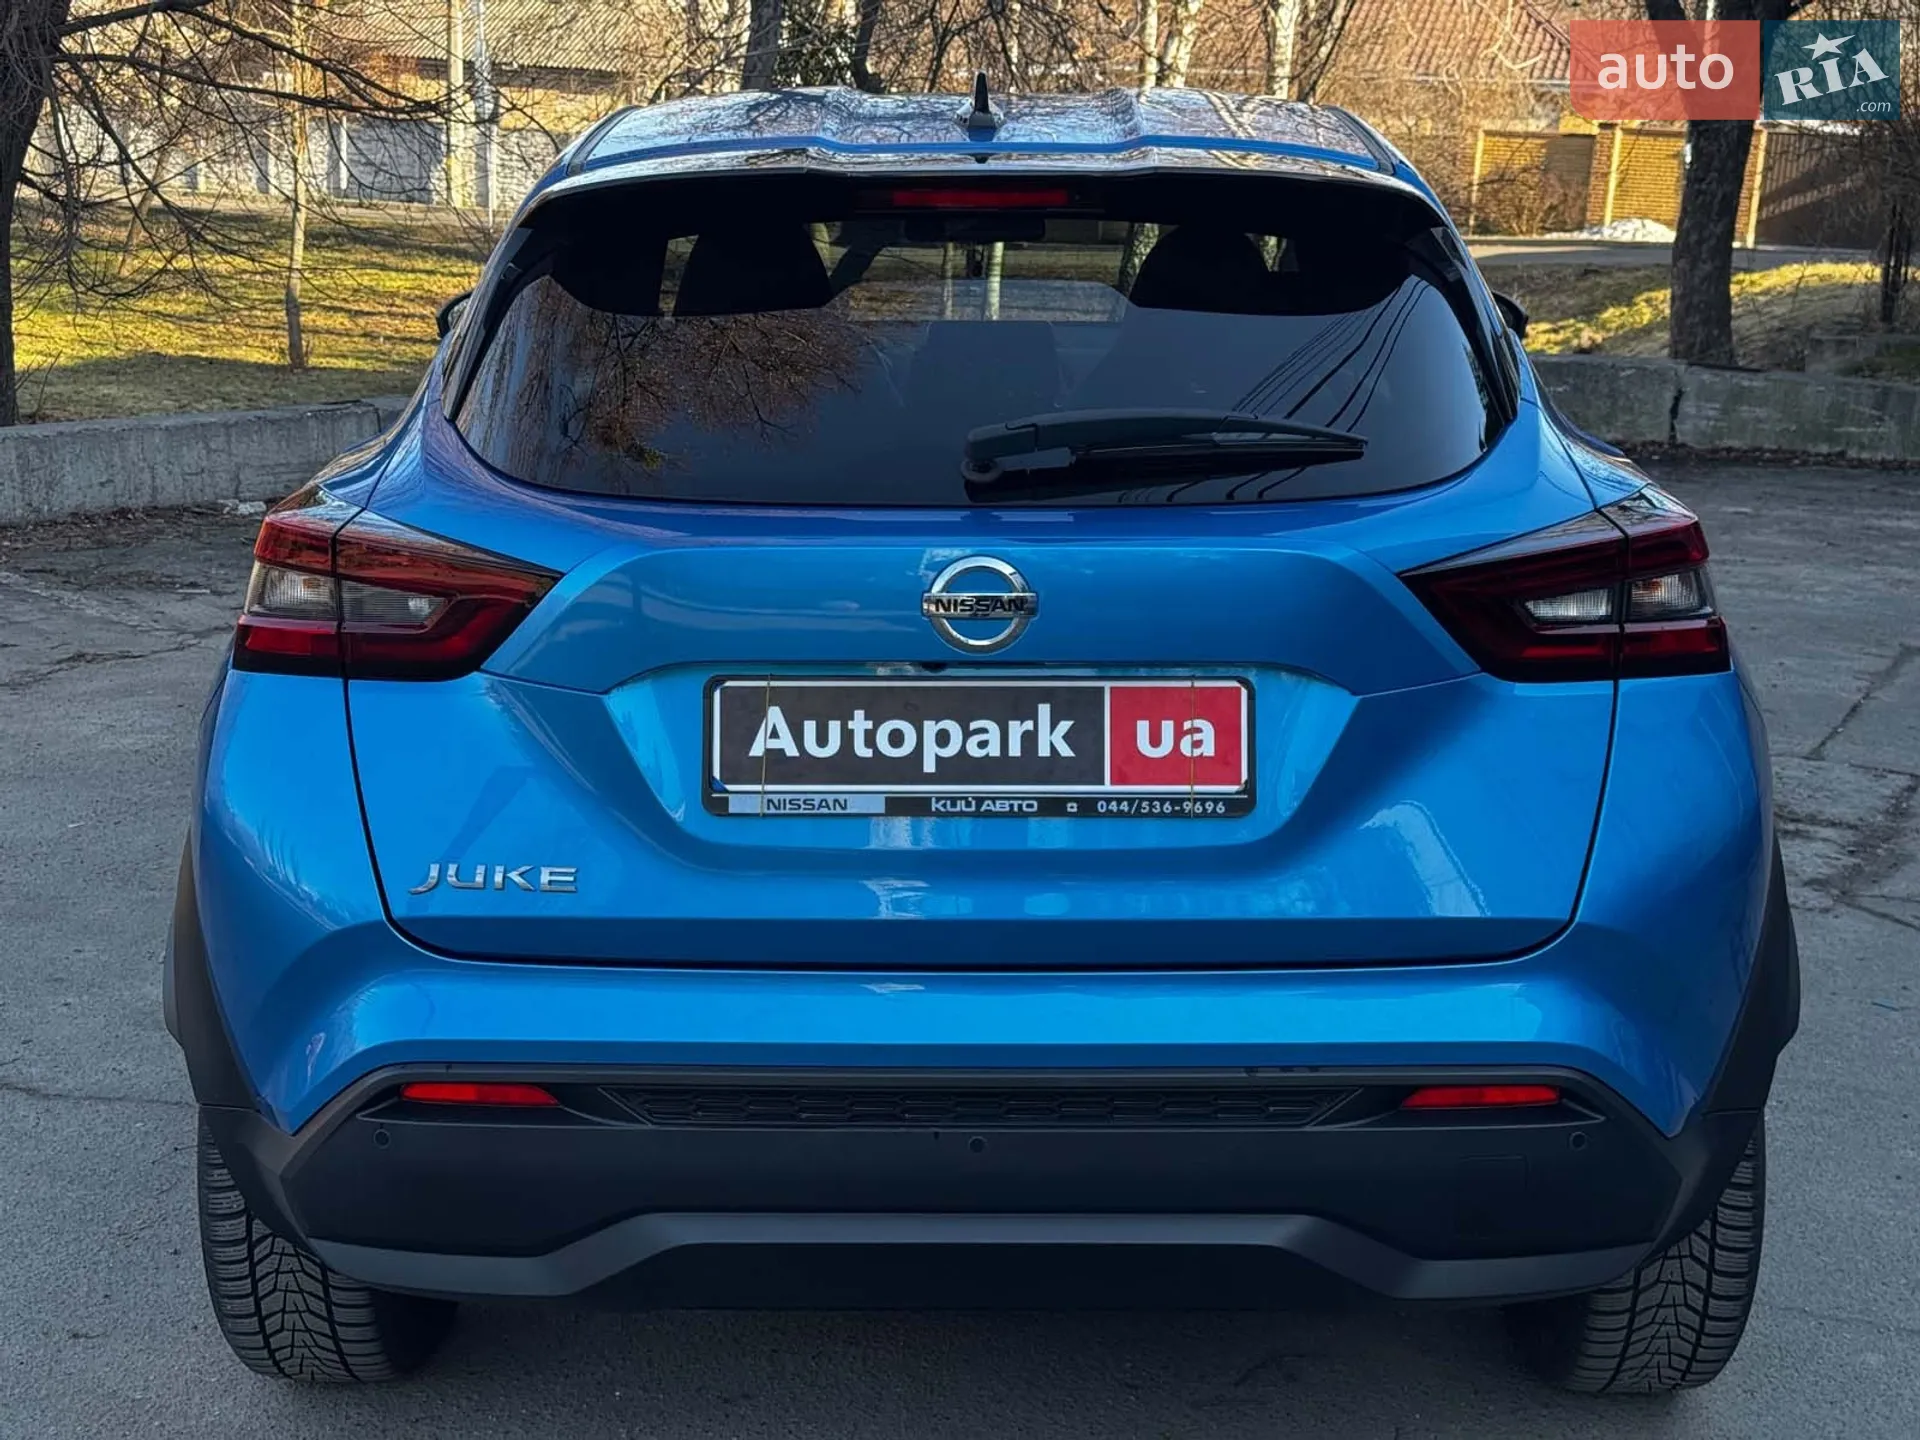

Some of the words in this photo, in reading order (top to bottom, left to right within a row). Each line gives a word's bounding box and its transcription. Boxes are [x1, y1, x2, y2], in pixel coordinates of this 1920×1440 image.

[935, 598, 1025, 613] NISSAN
[748, 703, 1076, 773] Autopark
[1136, 718, 1216, 759] ua
[766, 798, 848, 812] NISSAN
[1097, 800, 1226, 814] 044/536-9696
[408, 863, 578, 895] JUKE
